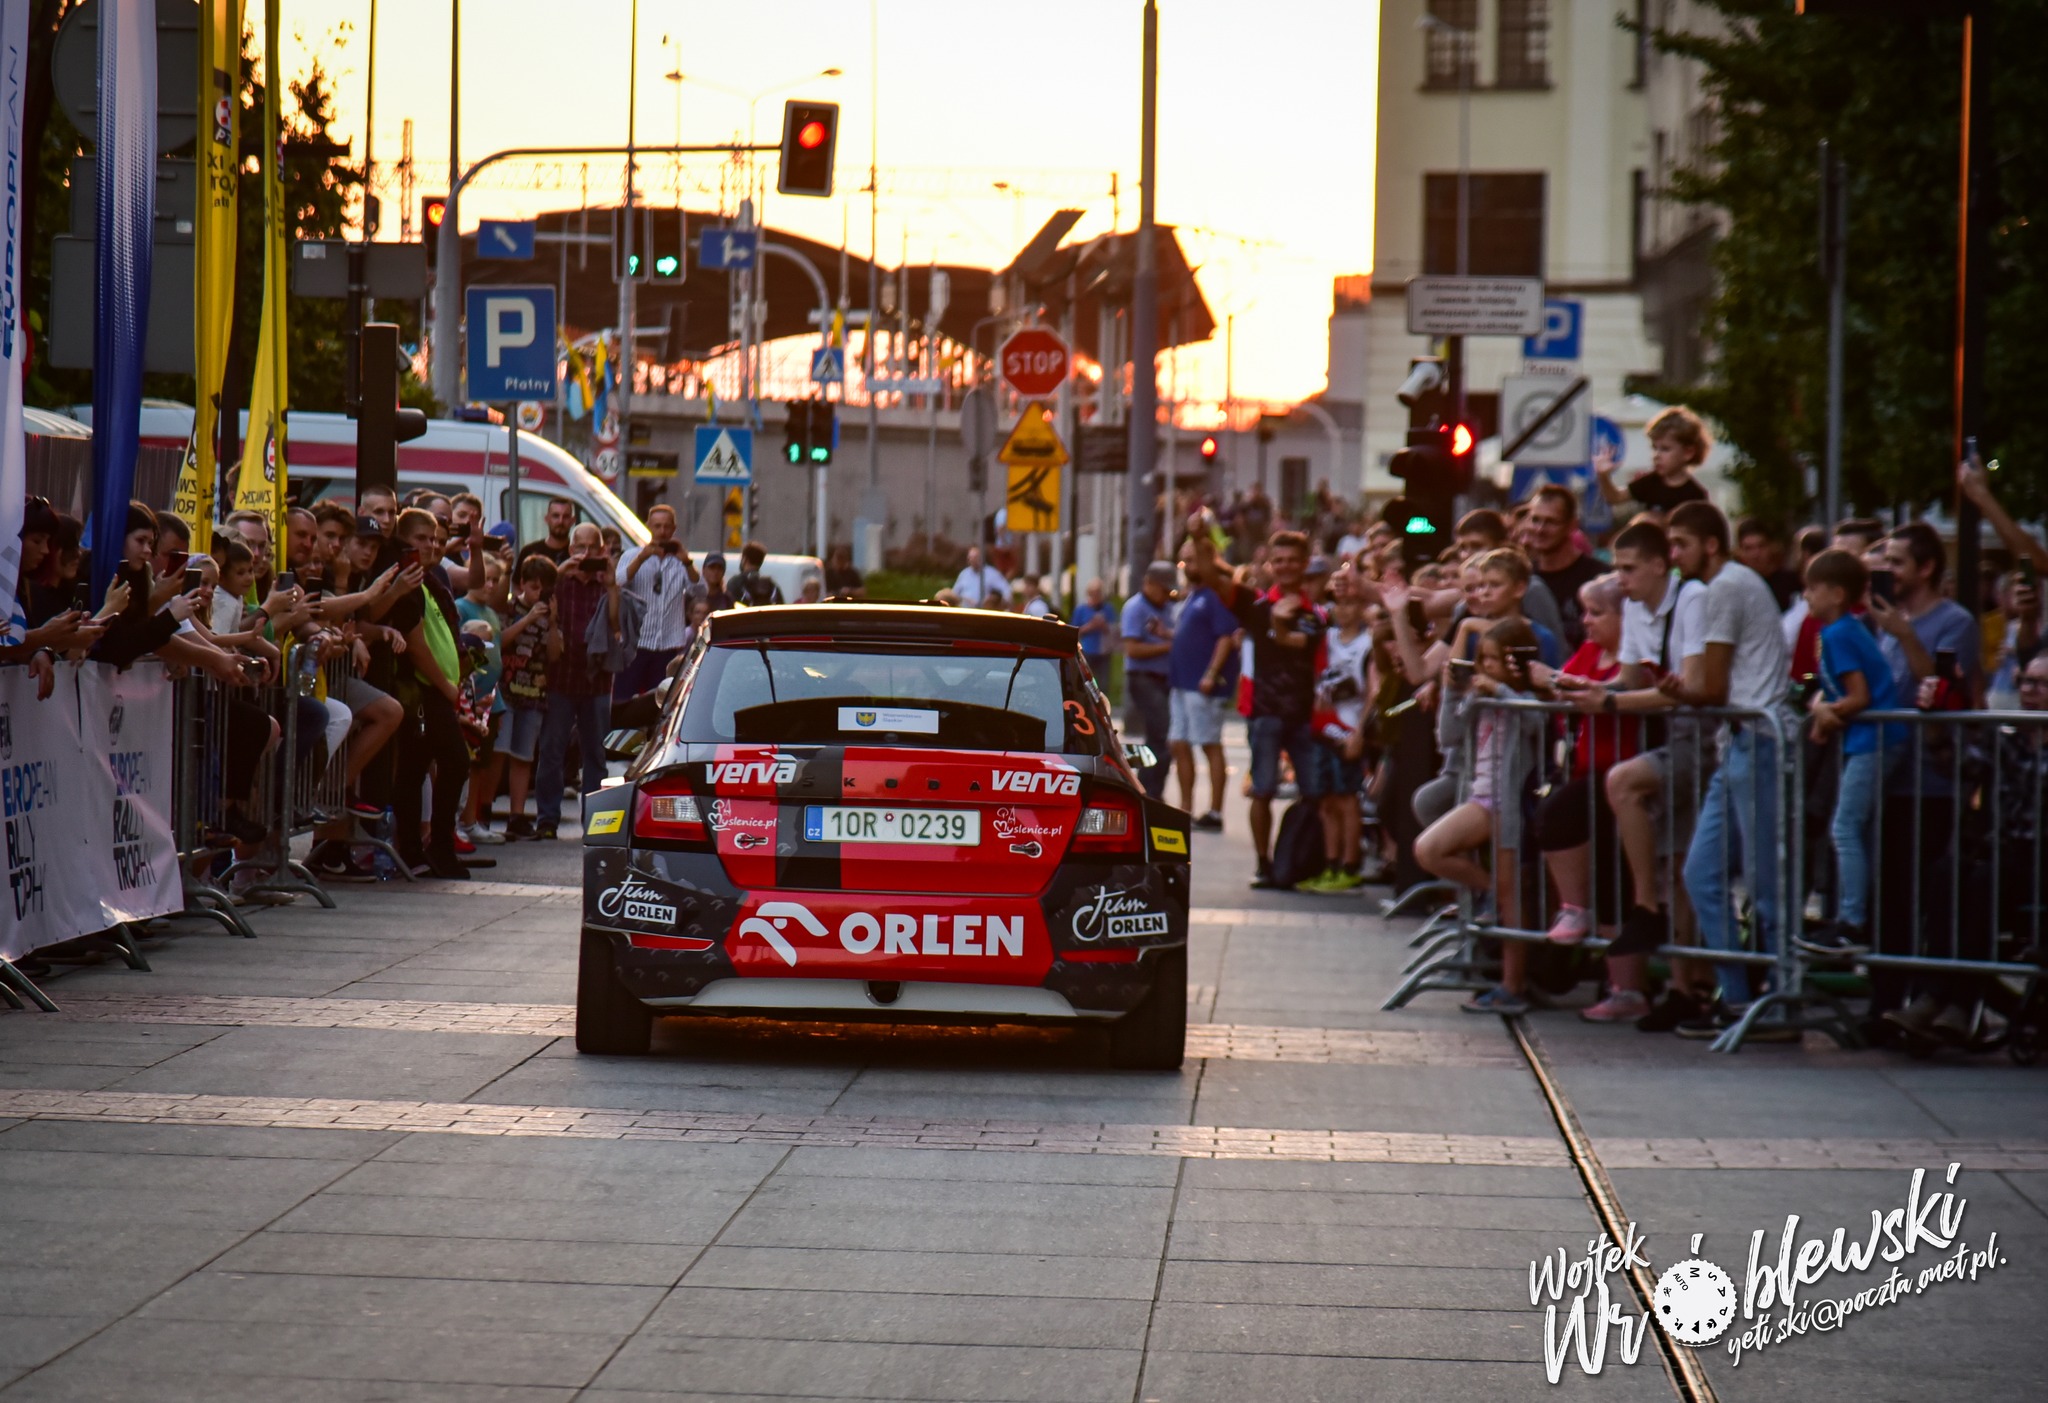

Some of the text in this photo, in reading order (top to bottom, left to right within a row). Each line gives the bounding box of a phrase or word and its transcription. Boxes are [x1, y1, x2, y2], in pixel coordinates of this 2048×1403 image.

[3, 45, 17, 360] EUROPEAN
[486, 297, 535, 368] P
[1006, 350, 1063, 375] STOP
[505, 376, 550, 394] Płatny
[1063, 700, 1095, 735] 3
[705, 761, 798, 784] verva
[992, 769, 1082, 795] verva
[807, 828, 820, 837] CZ
[831, 812, 966, 839] 10R 0239
[628, 904, 673, 921] ORLEN
[839, 912, 1024, 956] ORLEN
[1111, 917, 1164, 935] ORLEN
